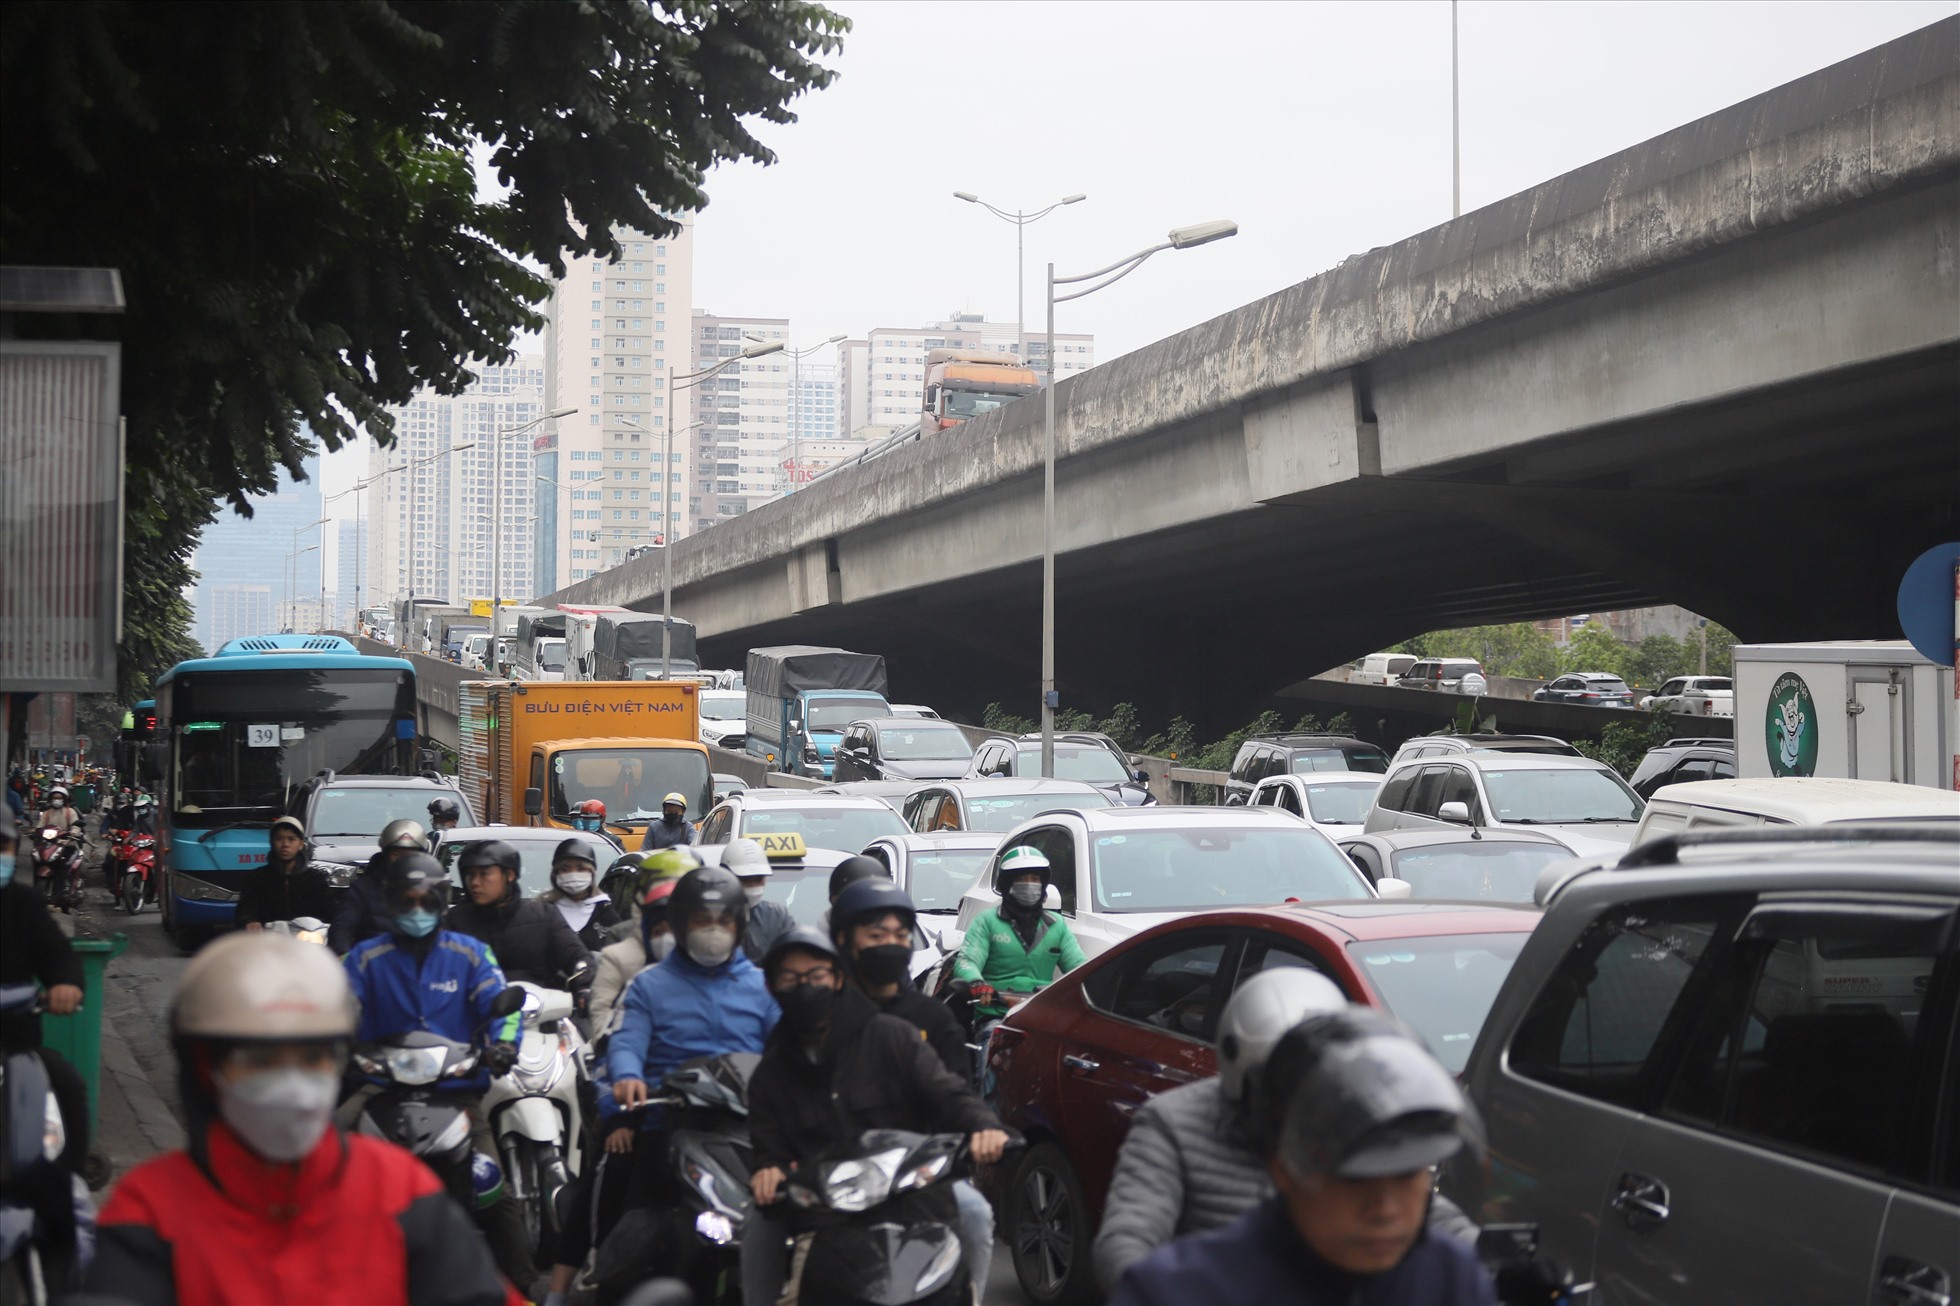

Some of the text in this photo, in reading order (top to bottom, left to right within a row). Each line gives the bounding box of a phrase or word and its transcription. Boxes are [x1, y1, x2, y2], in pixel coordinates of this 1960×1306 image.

[525, 699, 684, 716] BƯU ĐIỆN VIỆT NAM
[254, 729, 273, 744] 39
[1823, 976, 1870, 985] SUPER
